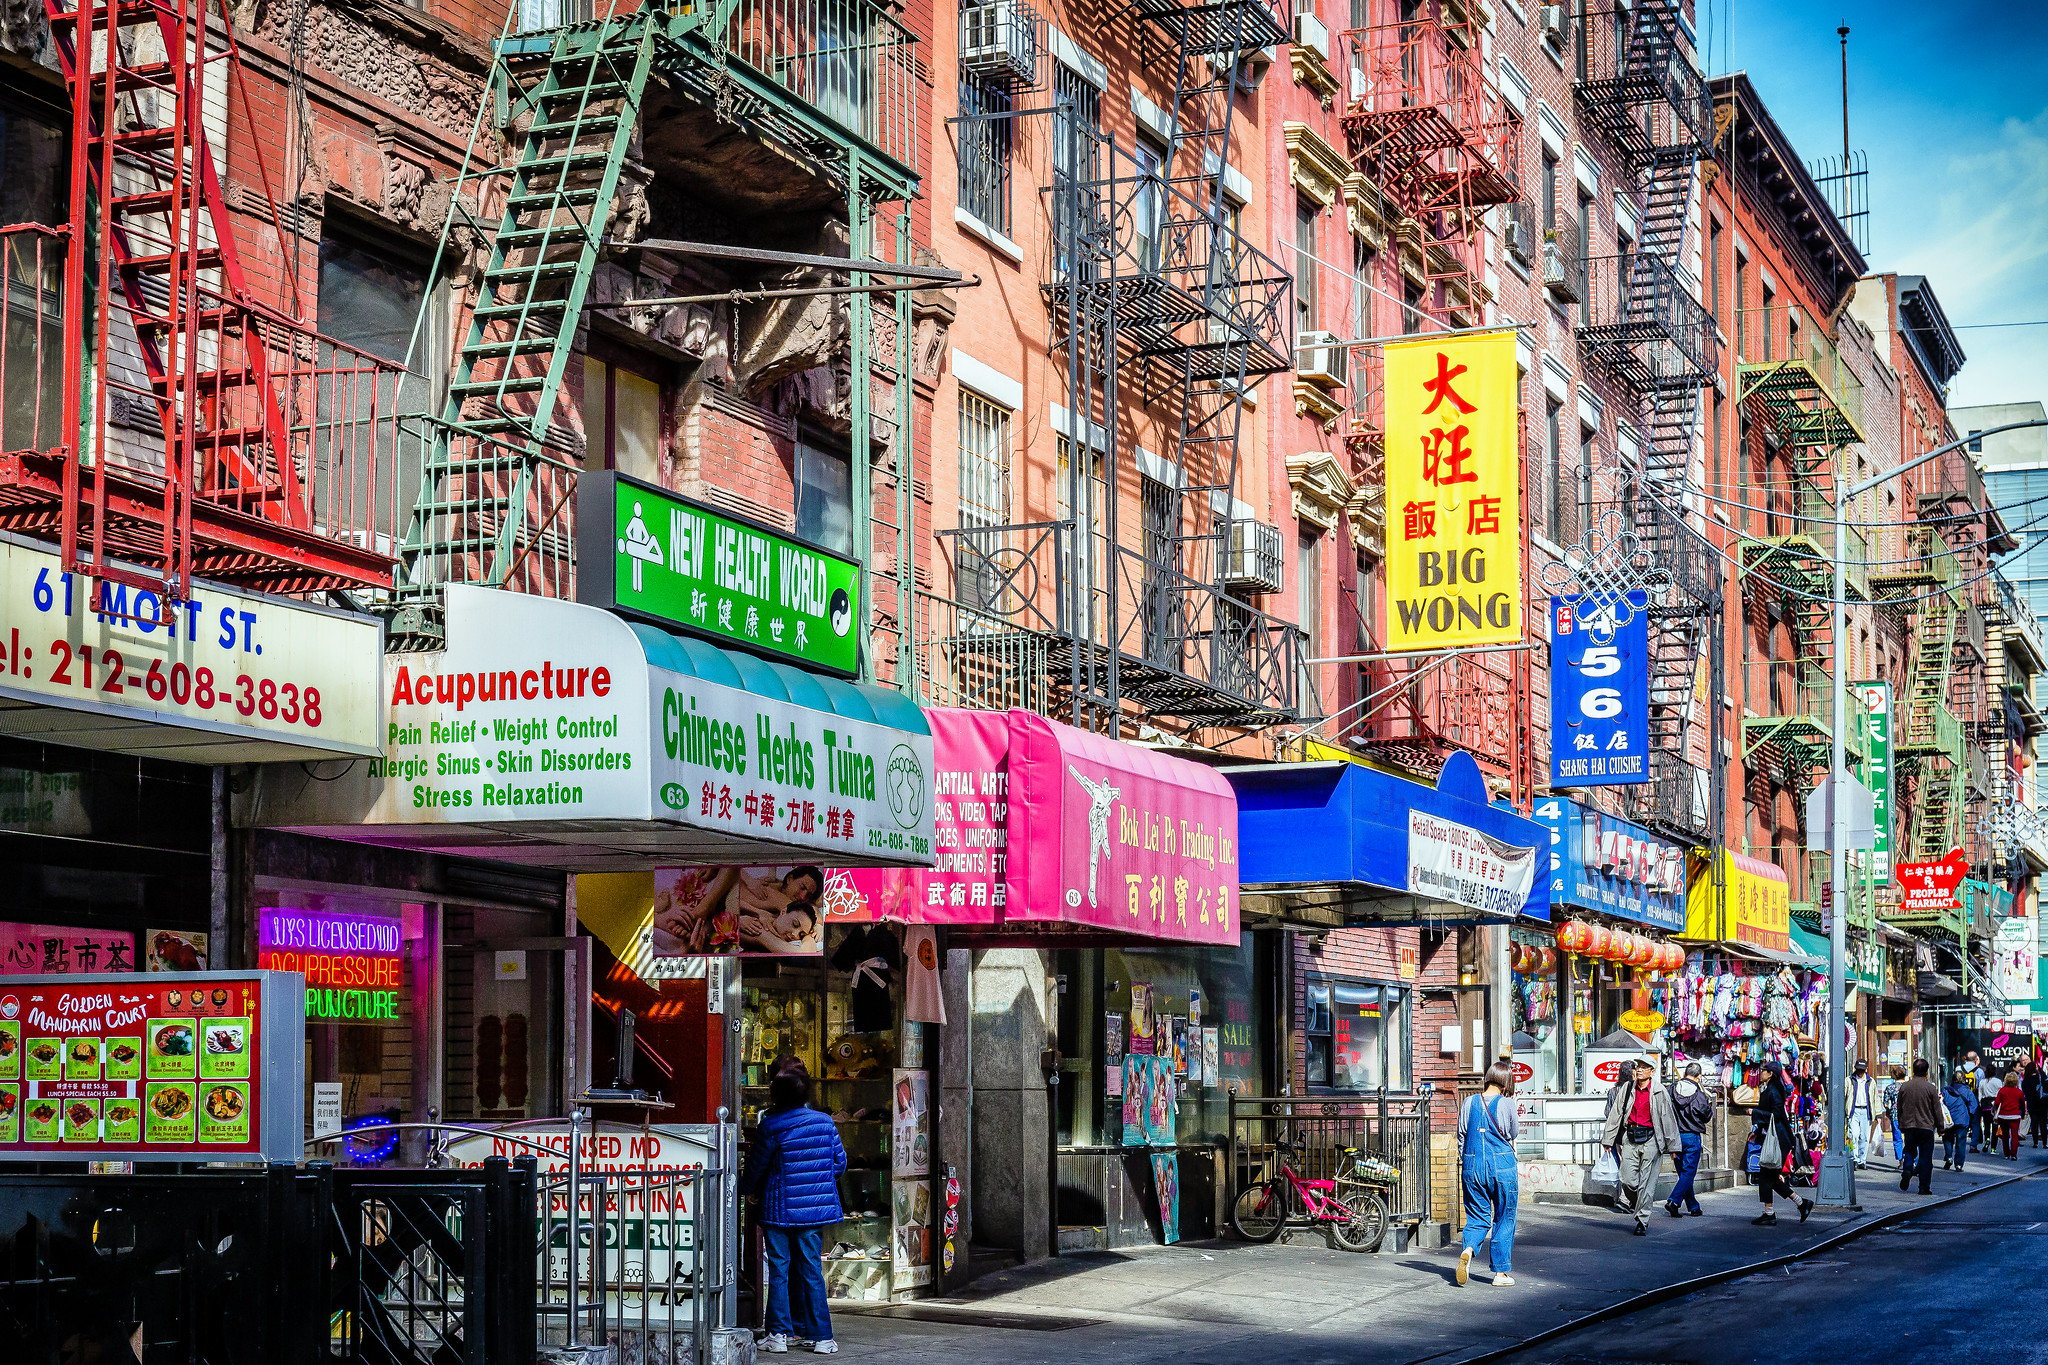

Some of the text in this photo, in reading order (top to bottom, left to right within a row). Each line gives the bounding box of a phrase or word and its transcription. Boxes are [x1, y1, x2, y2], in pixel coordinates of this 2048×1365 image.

[1403, 494, 1501, 541] 飯店
[670, 508, 827, 618] NEW HEALTH WORLD
[1418, 547, 1485, 587] BIG
[33, 568, 73, 617] 61
[218, 607, 263, 656] ST.
[690, 588, 808, 653] 新健康世界
[1396, 592, 1511, 635] WONG
[49, 640, 322, 728] 212-608-3838
[391, 661, 611, 711] Acupuncture
[388, 715, 617, 745] Pain Relief Weight Control
[663, 687, 876, 801] Chinese Herbs Tuina
[367, 748, 631, 782] Allergic Sinus Skin Dissorders
[1560, 756, 1642, 777] SHANG HAI CUISINE
[413, 782, 582, 808] Stress Relaxation
[666, 786, 684, 806] 63
[935, 772, 975, 795] ARTIAL
[935, 802, 1007, 825] OKS, VIDEO TAP
[868, 829, 929, 855] 212-608-7868
[935, 828, 959, 850] HOES,
[1120, 805, 1235, 871] Bok Lei Po Trading Inc.
[1413, 816, 1429, 837] Retail
[1430, 821, 1447, 843] Space
[1069, 893, 1078, 904] 63
[1906, 898, 1954, 908] PHARMACY
[1910, 888, 1949, 898] PEOPLES
[1402, 949, 1414, 964] ATM
[58, 994, 112, 1015] GOLDEN
[305, 989, 399, 1019] PUNCTURE
[28, 1007, 101, 1035] MANDARIN
[105, 1004, 148, 1029] COURT
[1224, 1024, 1251, 1046] SALE
[1983, 1046, 2030, 1056] The YEON
[494, 1137, 530, 1157] NYS
[630, 1138, 661, 1158] MD
[650, 1224, 693, 1247] RUB
